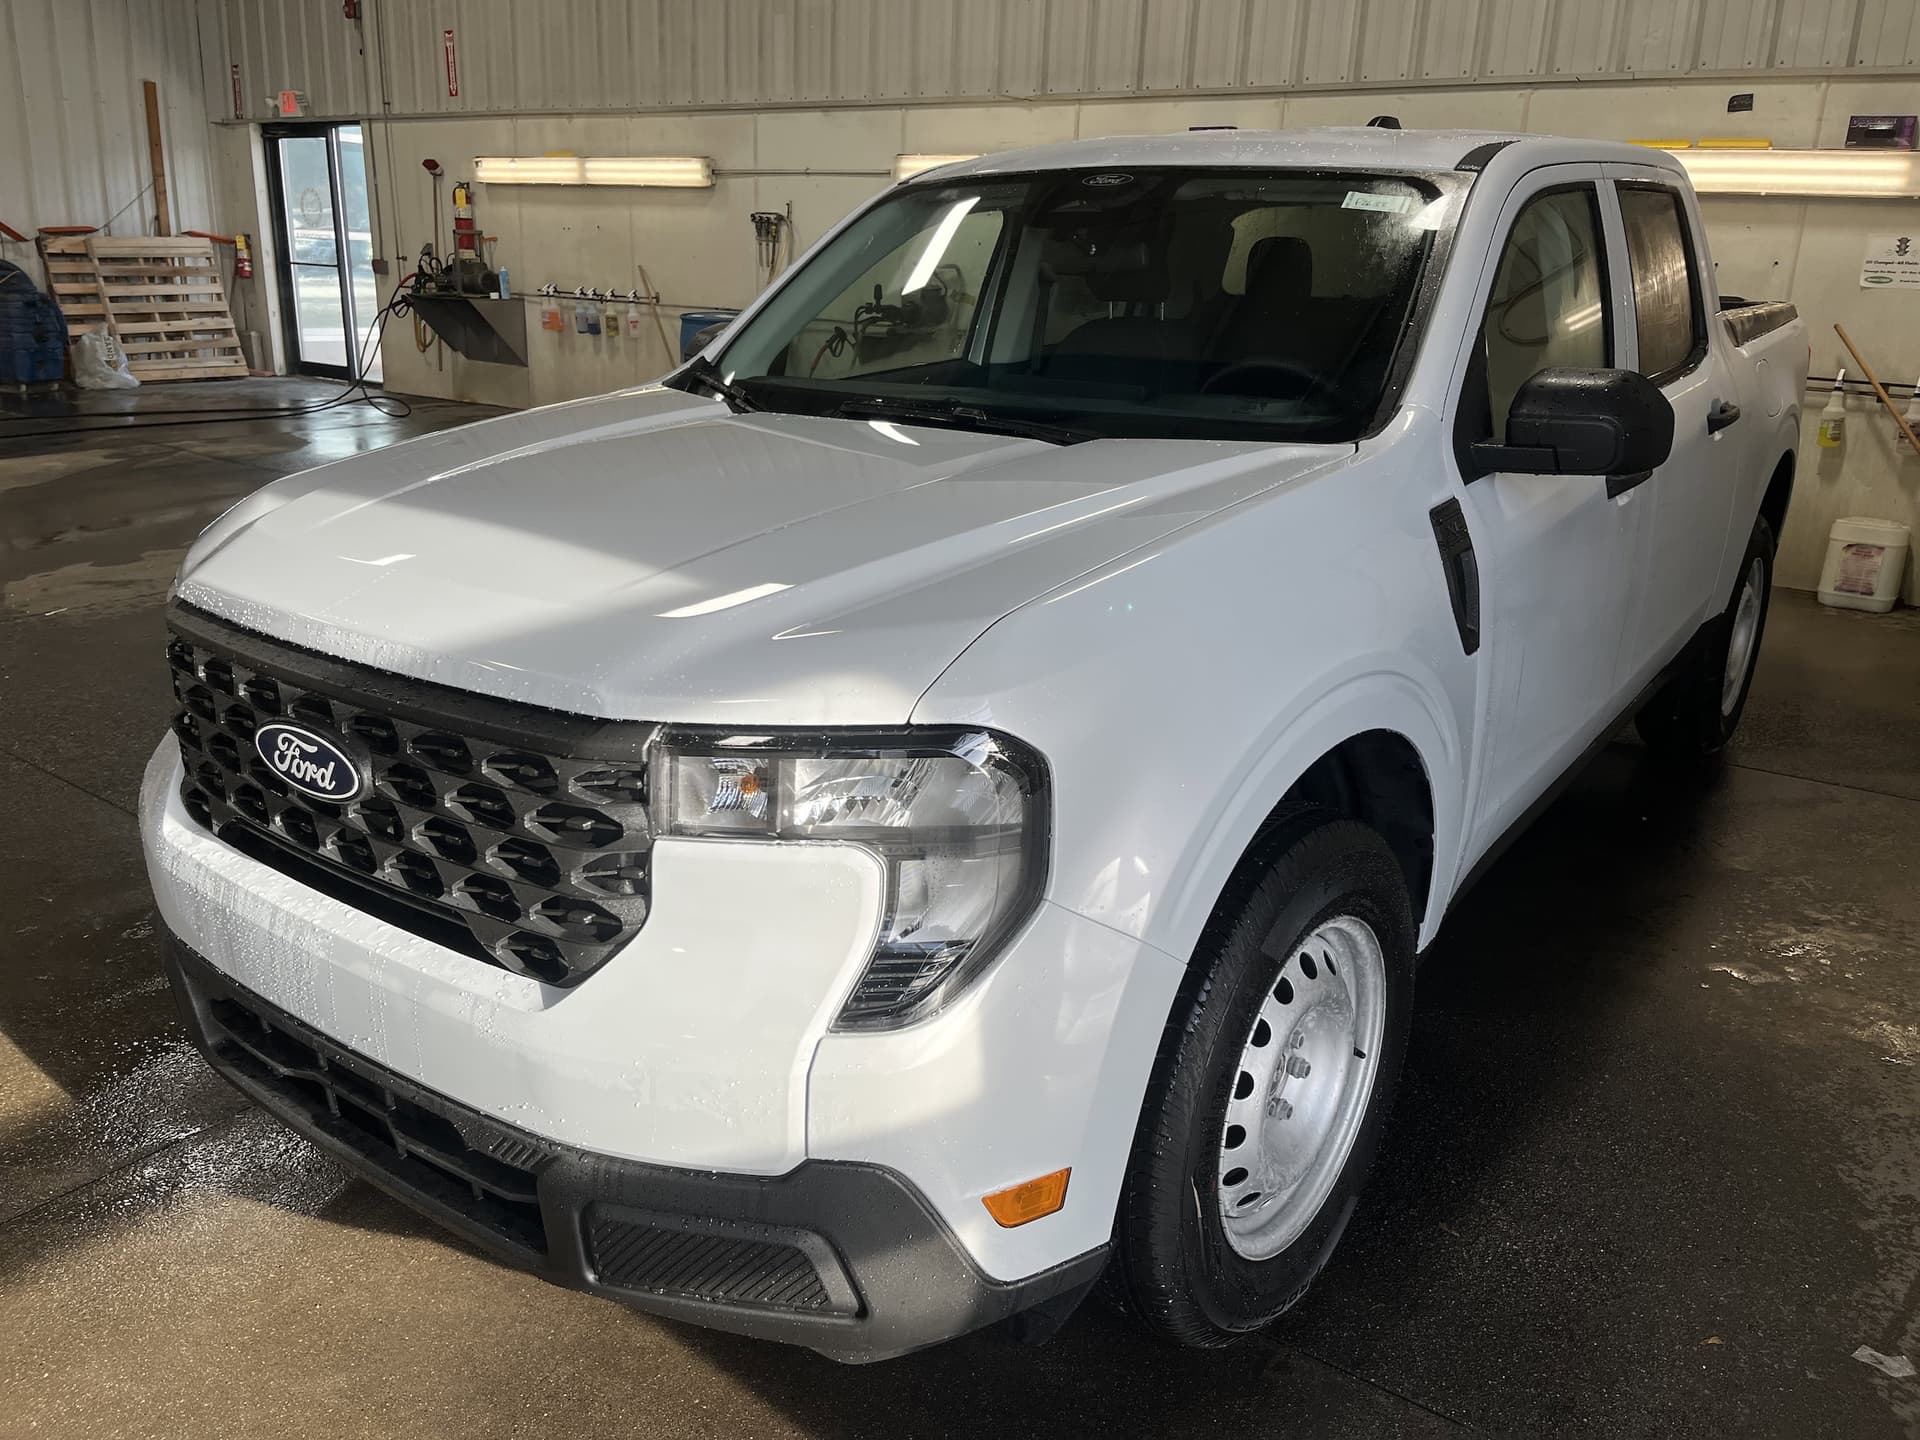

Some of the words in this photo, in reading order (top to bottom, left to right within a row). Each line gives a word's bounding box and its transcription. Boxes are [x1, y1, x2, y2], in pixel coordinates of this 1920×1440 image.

[1089, 175, 1126, 185] Ford
[103, 337, 114, 359] SAND
[274, 732, 336, 791] Ford
